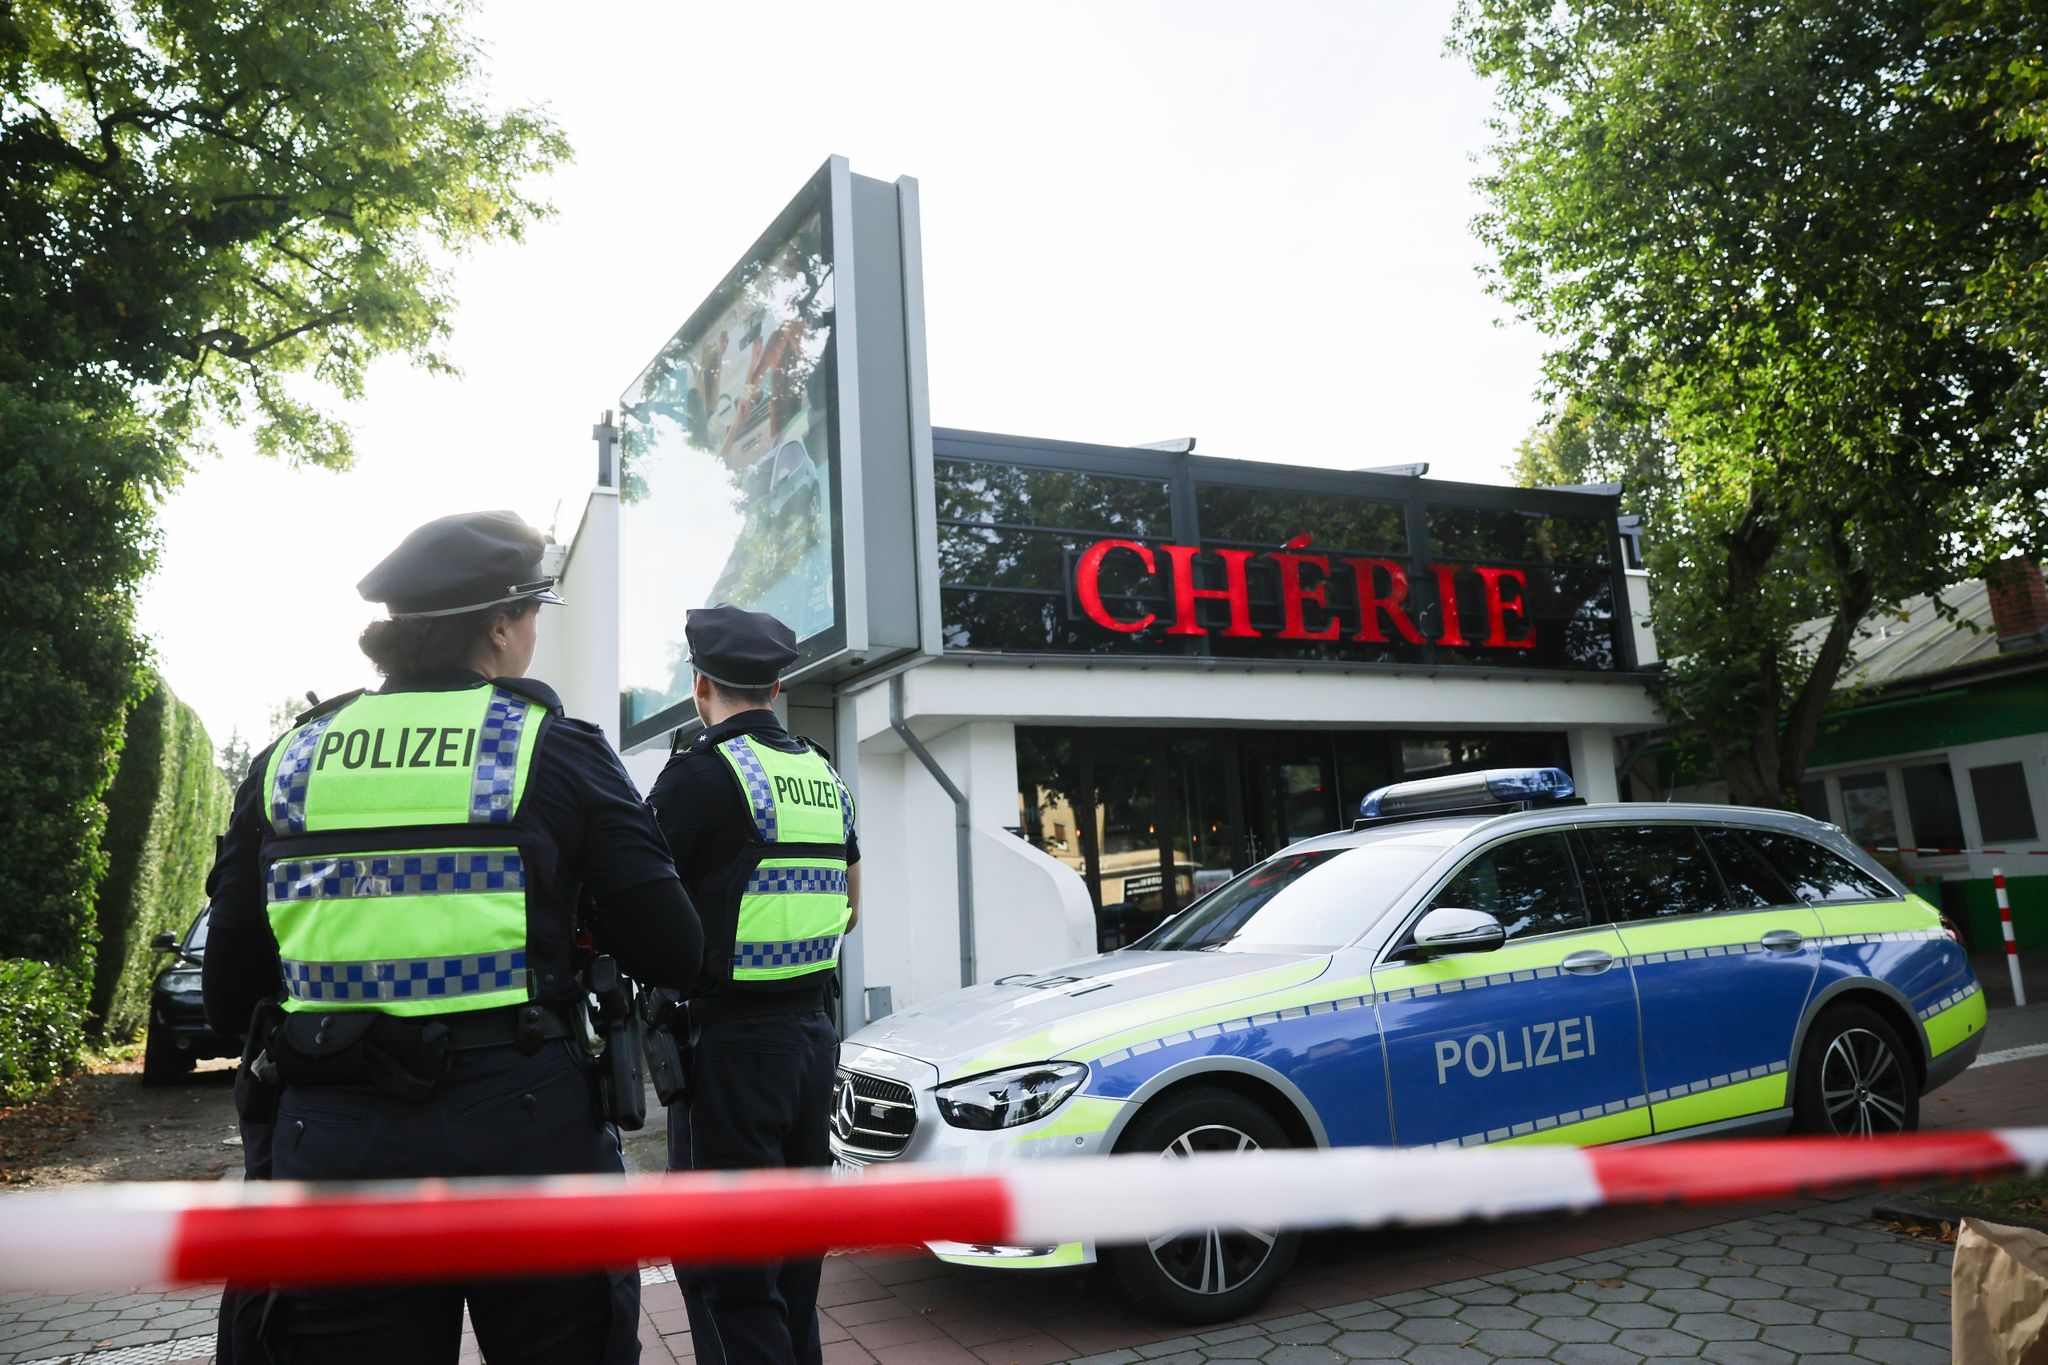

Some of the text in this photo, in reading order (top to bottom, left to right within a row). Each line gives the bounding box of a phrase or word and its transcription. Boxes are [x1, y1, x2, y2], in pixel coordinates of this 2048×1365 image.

[1076, 532, 1537, 649] CHÉRIE
[316, 727, 476, 771] POLIZEI
[773, 775, 838, 810] POLIZEI
[1435, 1015, 1596, 1085] POLIZEI
